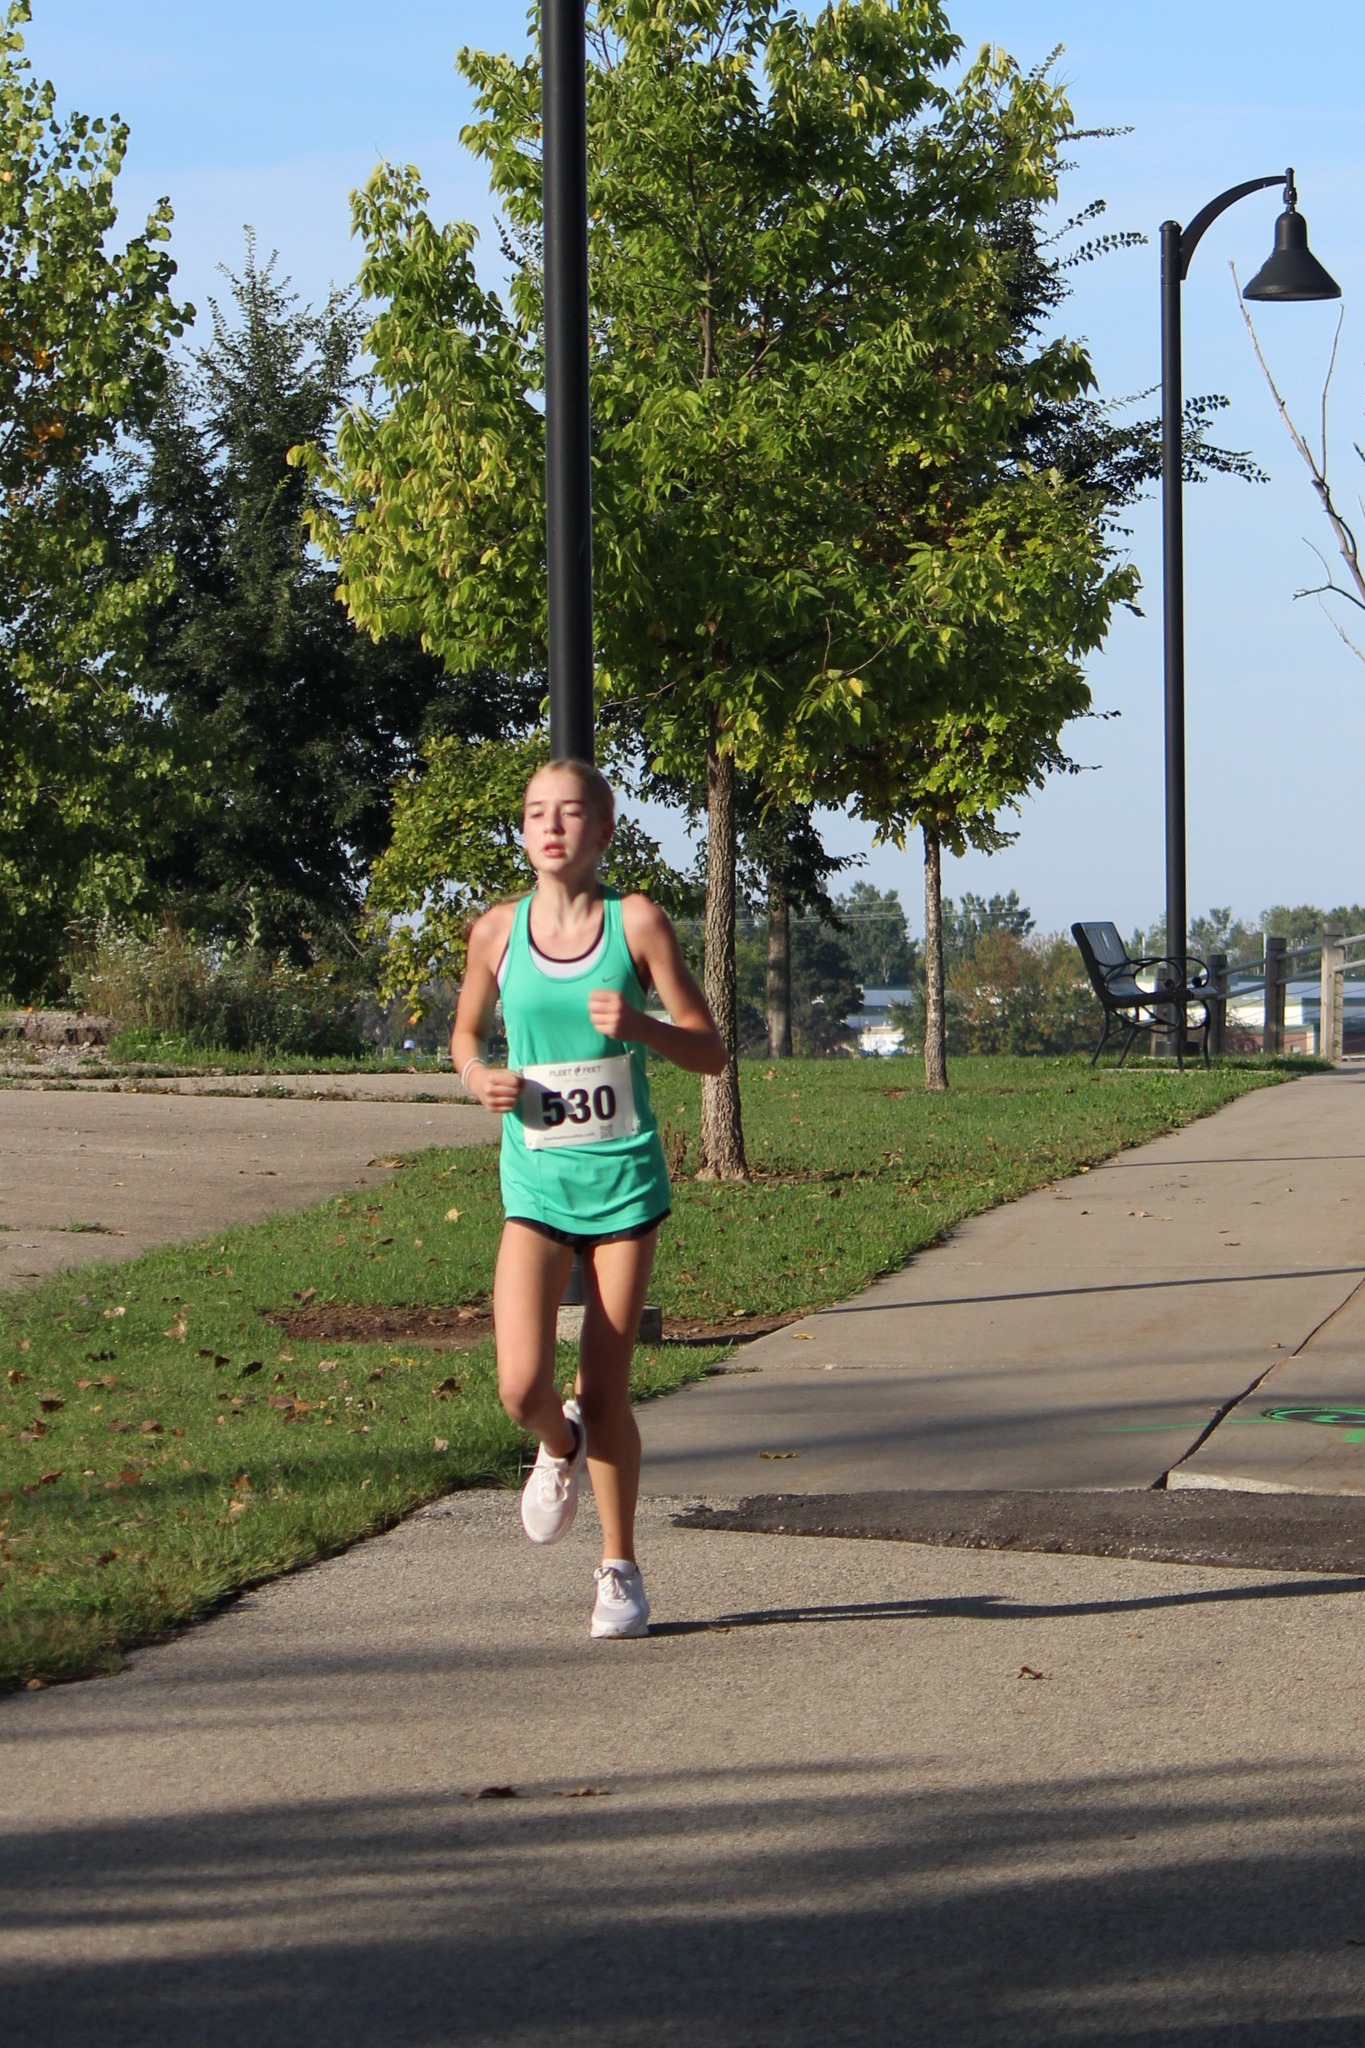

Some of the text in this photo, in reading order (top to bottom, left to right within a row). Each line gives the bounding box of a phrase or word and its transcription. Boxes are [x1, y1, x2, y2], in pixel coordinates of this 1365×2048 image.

[549, 1065, 602, 1078] FLEET FEET
[541, 1084, 617, 1127] 530
